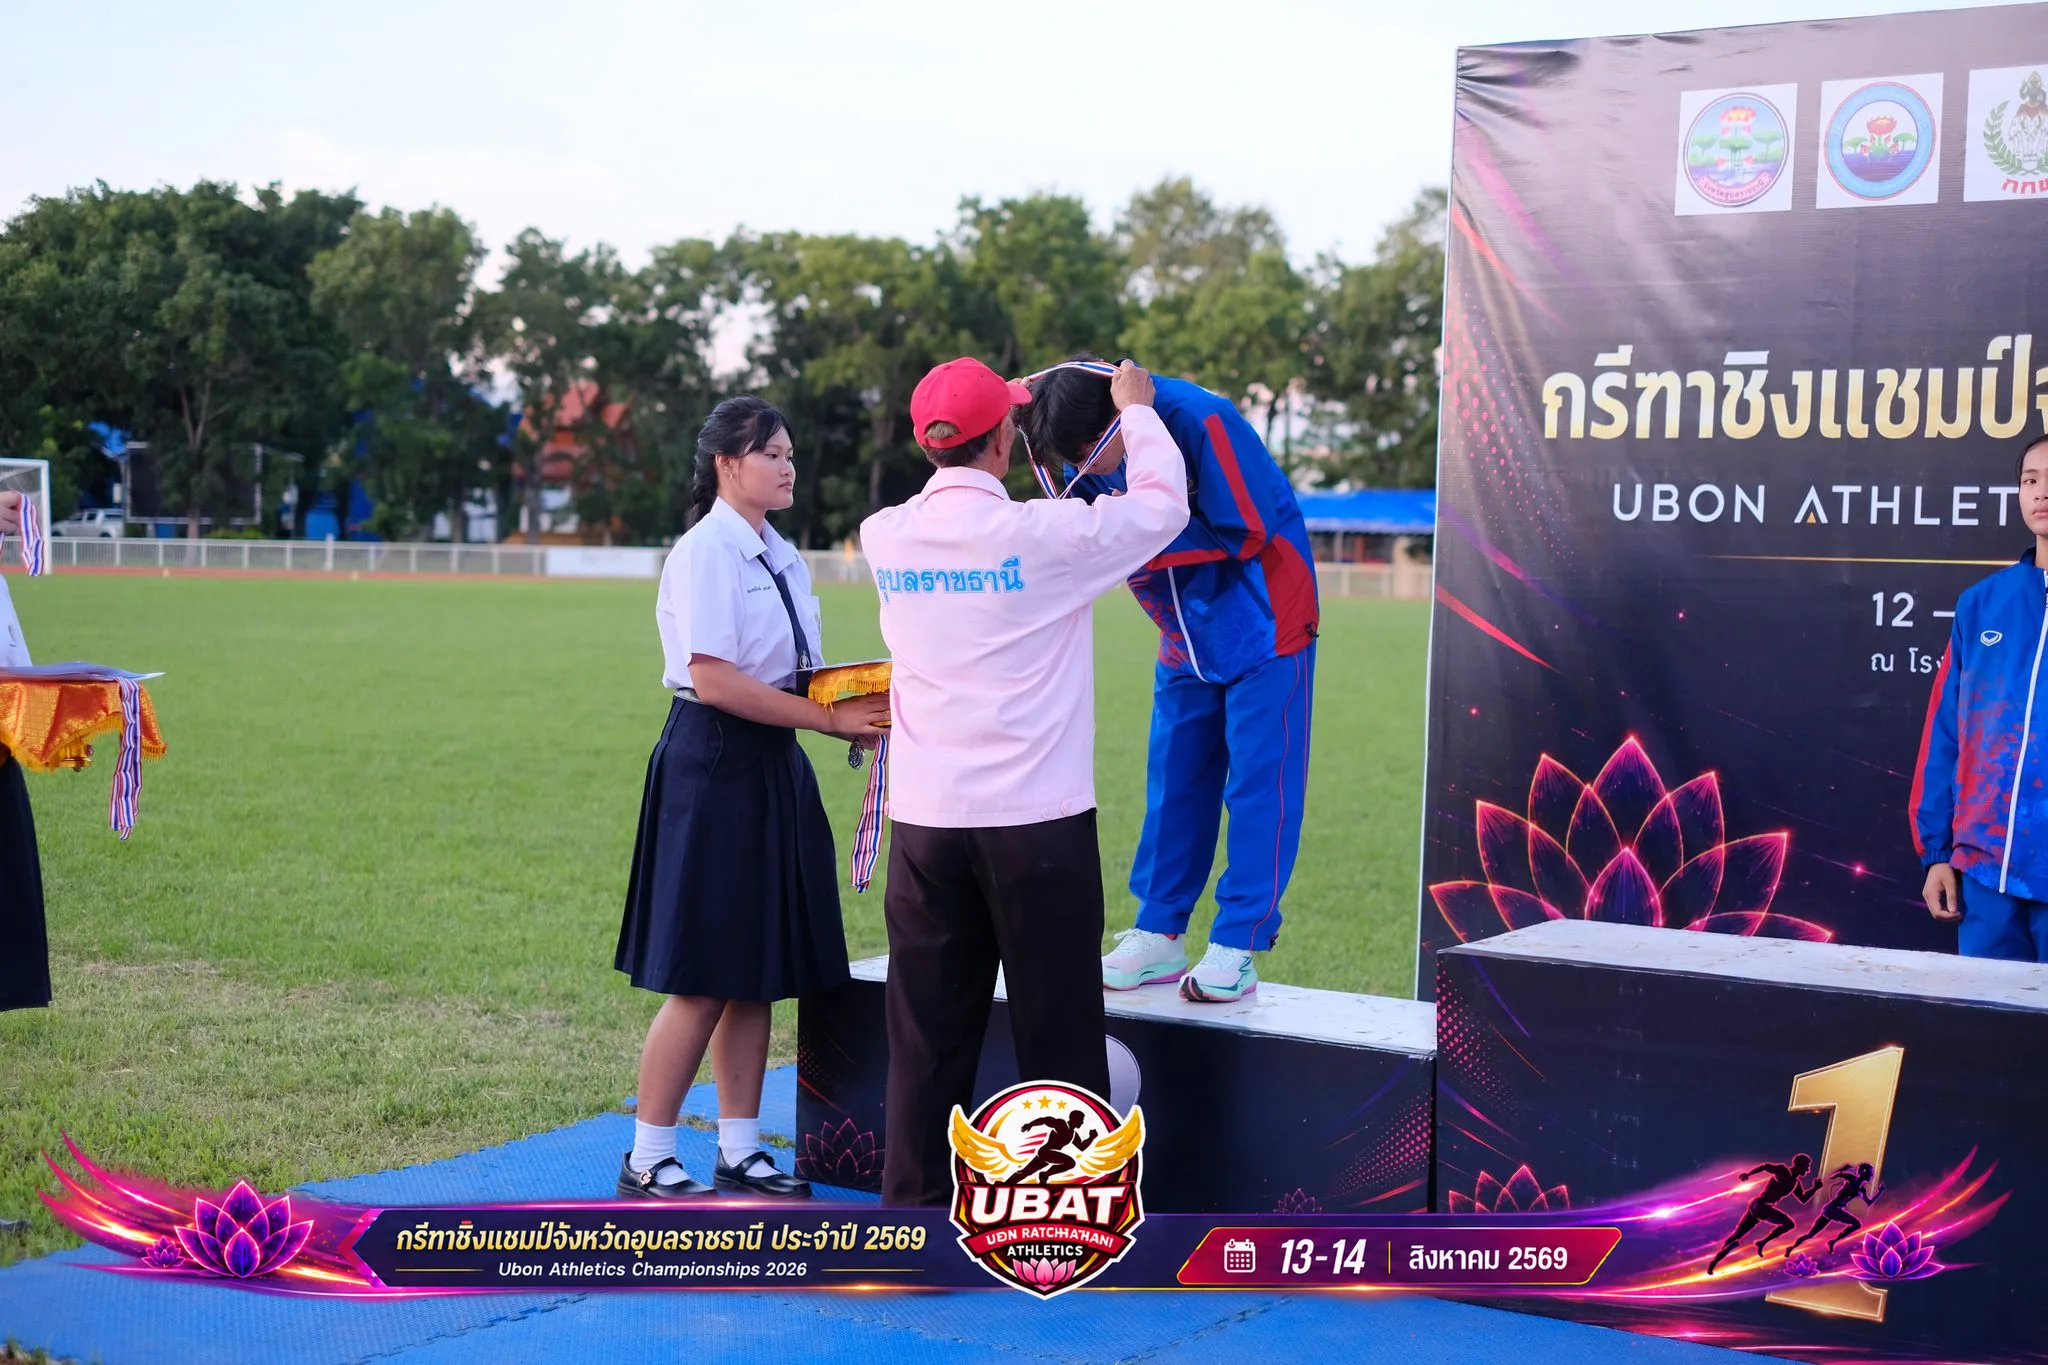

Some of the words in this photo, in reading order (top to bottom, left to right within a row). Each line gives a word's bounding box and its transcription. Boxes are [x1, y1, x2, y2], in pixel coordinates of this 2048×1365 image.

[1542, 334, 2048, 440] กรีฑาชิงแชมป์
[1613, 483, 1765, 523] UBON
[1794, 485, 2020, 526] ATHLET
[1872, 592, 1914, 627] 12
[1871, 652, 1894, 672] ณ
[1764, 1046, 1904, 1322] 1
